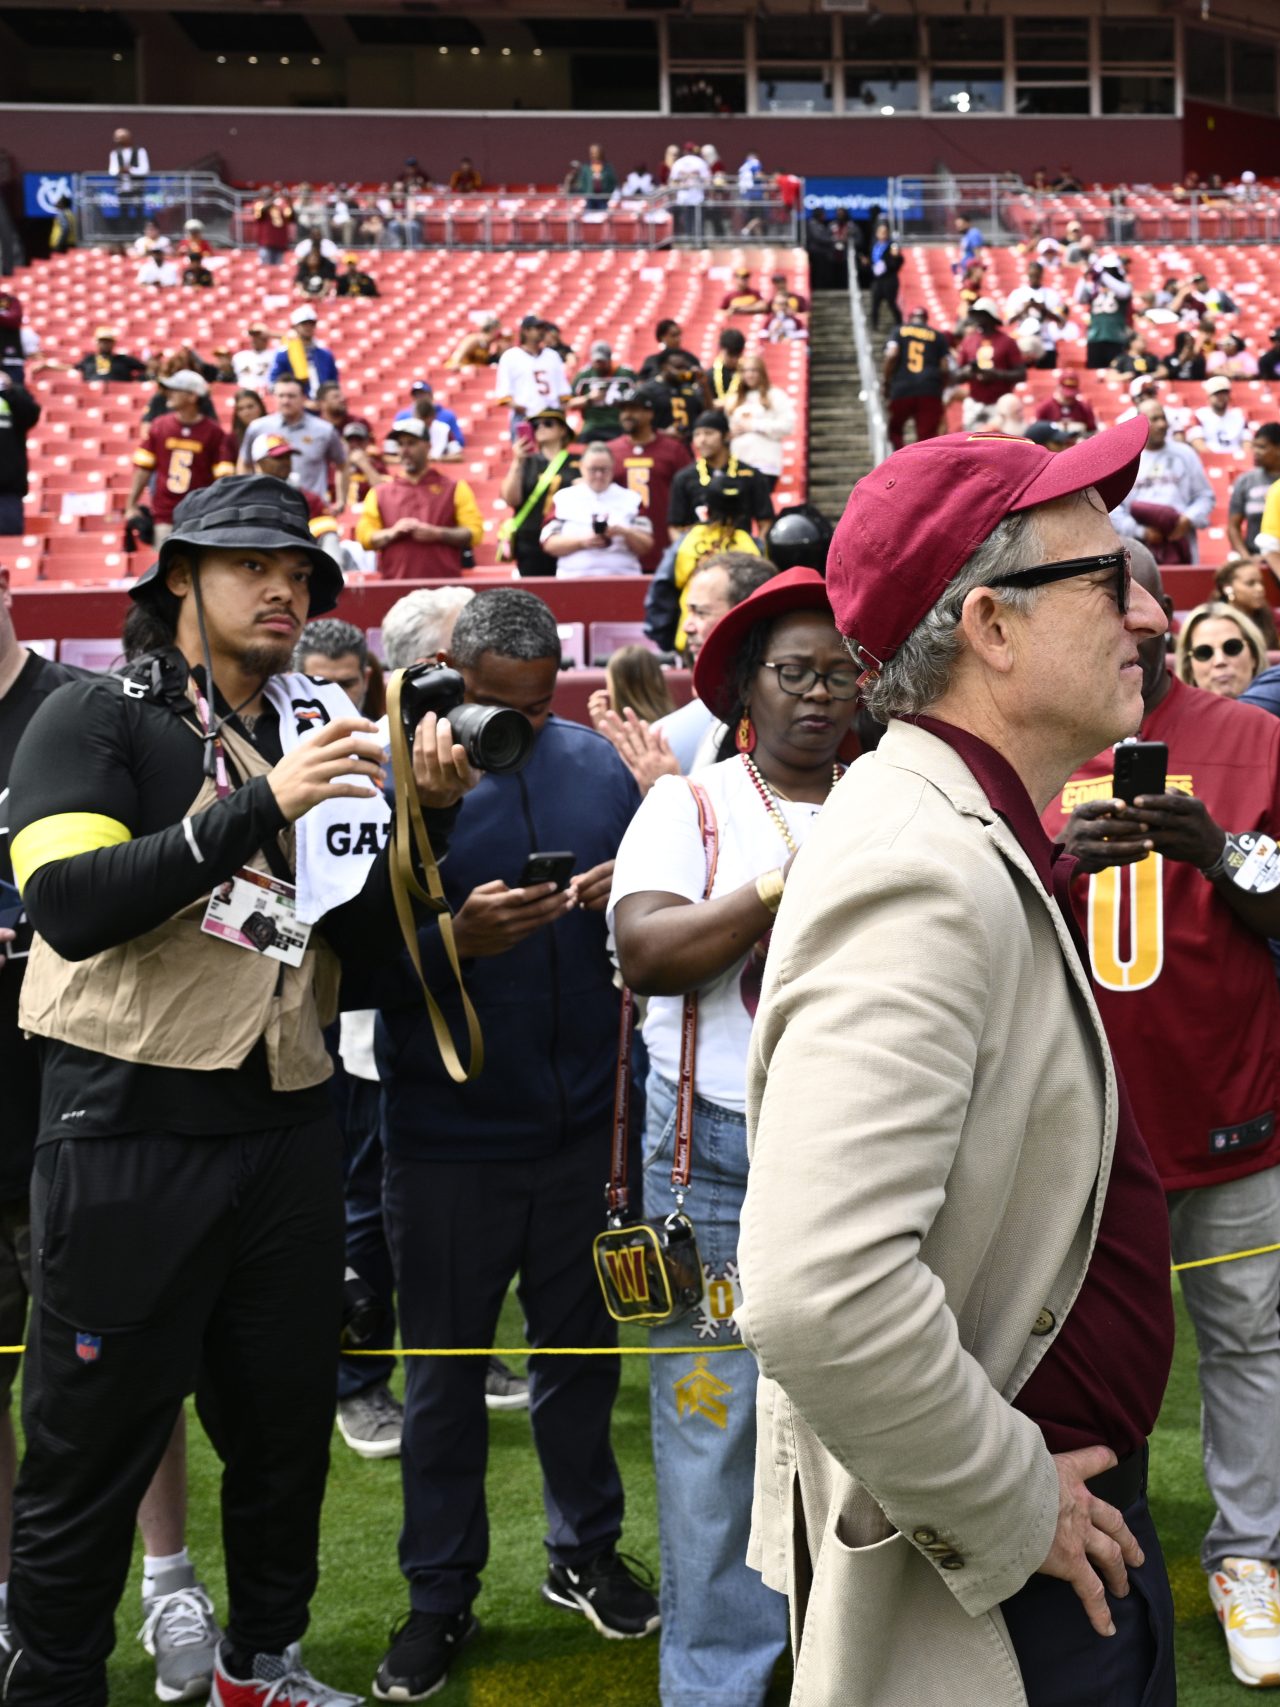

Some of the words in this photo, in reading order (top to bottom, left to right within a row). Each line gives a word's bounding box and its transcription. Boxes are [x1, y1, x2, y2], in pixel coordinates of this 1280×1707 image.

[534, 370, 550, 396] 5
[166, 449, 194, 494] 5
[679, 1081, 690, 1139] Commanders
[604, 1246, 650, 1303] W
